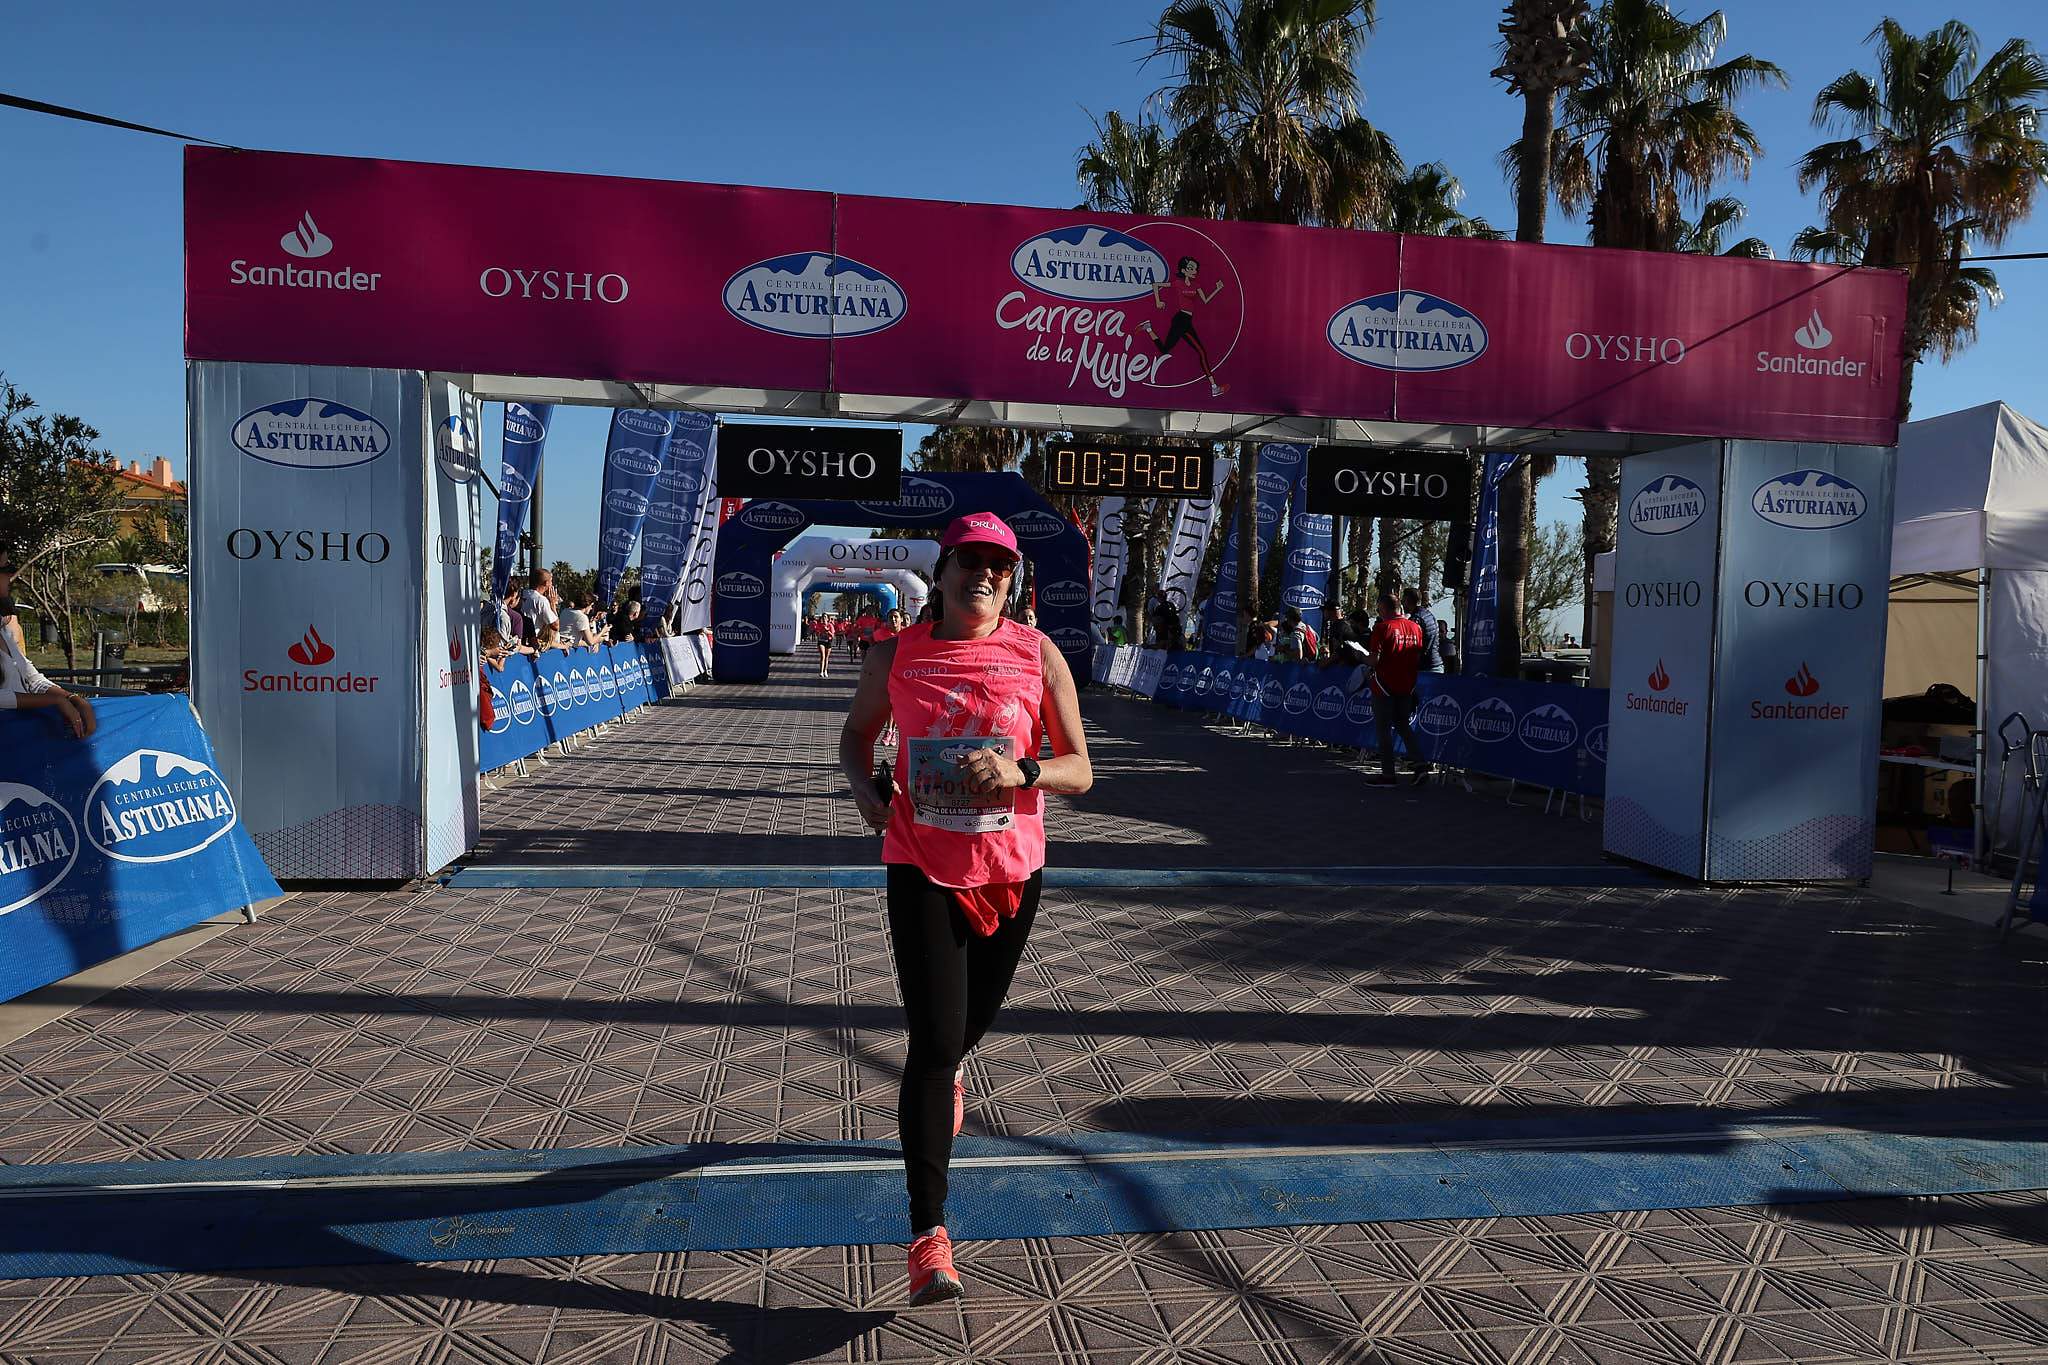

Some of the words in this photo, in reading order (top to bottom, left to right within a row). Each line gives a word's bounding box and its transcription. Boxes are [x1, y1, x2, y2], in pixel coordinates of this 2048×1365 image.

[1023, 249, 1156, 286] ASTURIANA
[1048, 248, 1098, 260] CENTRAL
[1103, 251, 1153, 263] LECHERA
[231, 259, 382, 291] Santander
[480, 267, 629, 303] OYSHO
[766, 279, 824, 291] CENTRAL
[829, 281, 888, 294] LECHERA
[737, 280, 893, 318] ASTURIANA
[995, 291, 1126, 337] Carrera
[1365, 316, 1415, 327] CENTRAL
[1420, 319, 1472, 330] LECHERA
[1339, 317, 1476, 353] ASTURIANA
[1565, 332, 1686, 365] OYSHO
[1026, 335, 1051, 361] de
[1055, 335, 1073, 363] la
[1068, 335, 1173, 398] Mujer
[1756, 351, 1867, 377] Santander
[268, 421, 319, 431] CENTRAL
[323, 423, 374, 433] LECHERA
[622, 413, 667, 433] ASTURIANA
[243, 422, 379, 453] ASTURIANA
[613, 454, 657, 473] ASTURIANA
[748, 448, 876, 479] OYSHO
[1057, 450, 1201, 490] 00:39:20
[1334, 469, 1448, 499] OYSHO
[1633, 501, 1700, 523] ASTURIANA
[1759, 490, 1858, 516] ASTURIANA
[744, 511, 800, 526] ASTURIANA
[1297, 515, 1332, 532] ASTURIA
[226, 528, 390, 564] OYSHO
[436, 534, 476, 568] OYSHO
[829, 543, 909, 562] OYSHO
[1094, 512, 1123, 622] OYSHO
[1625, 580, 1701, 608] OYSHO
[1744, 580, 1864, 610] OYSHO
[244, 669, 379, 693] Santander
[903, 665, 948, 680] OYSHO
[1626, 692, 1689, 716] Santander
[1751, 700, 1849, 720] Santander
[1468, 711, 1511, 734] ASTURIANA
[1521, 720, 1570, 743] ASTURIANA
[115, 784, 165, 805] CENTRAL
[166, 776, 217, 794] LECHERA
[100, 791, 233, 846] ASTURIANA
[940, 807, 949, 815] DE
[971, 818, 998, 828] Santand
[0, 827, 71, 876] RIANA
